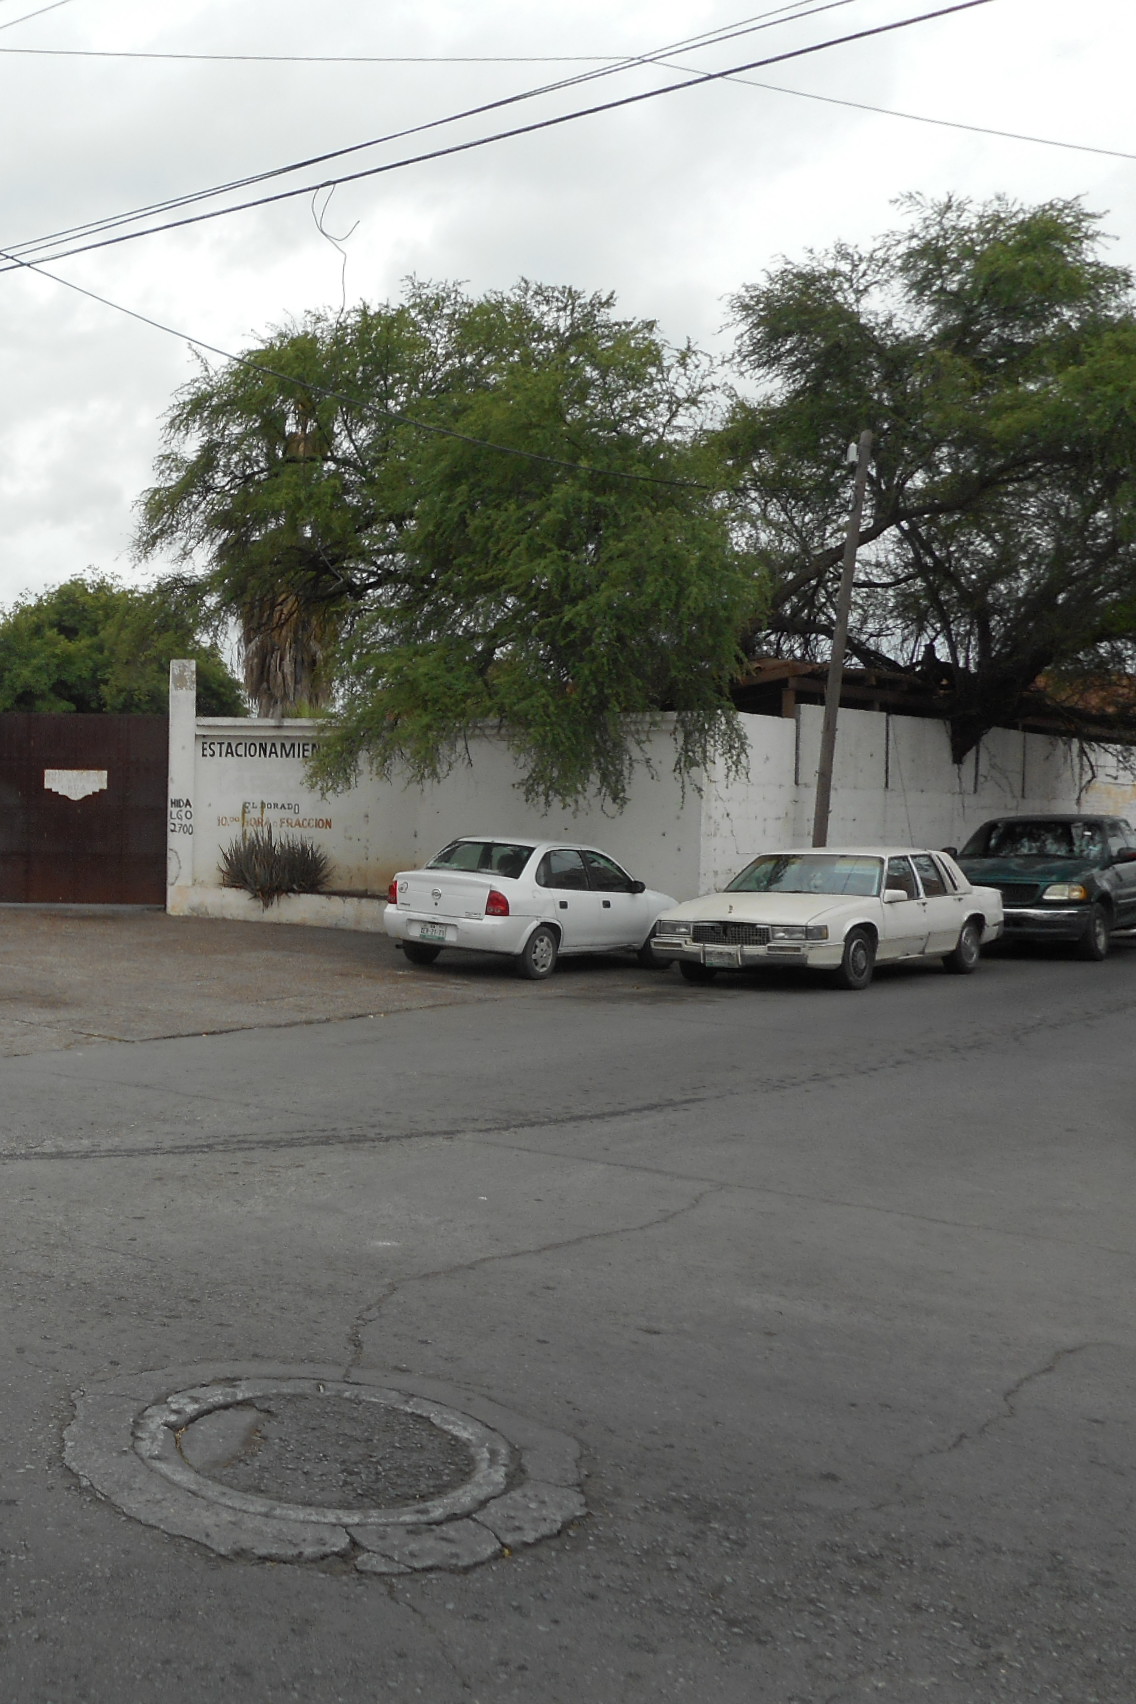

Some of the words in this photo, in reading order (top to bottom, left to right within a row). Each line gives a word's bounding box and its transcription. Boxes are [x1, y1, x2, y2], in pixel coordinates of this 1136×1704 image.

[170, 798, 192, 809] HIDA
[170, 810, 193, 821] LGO
[170, 822, 194, 835] 2700
[279, 817, 333, 830] FRACCION
